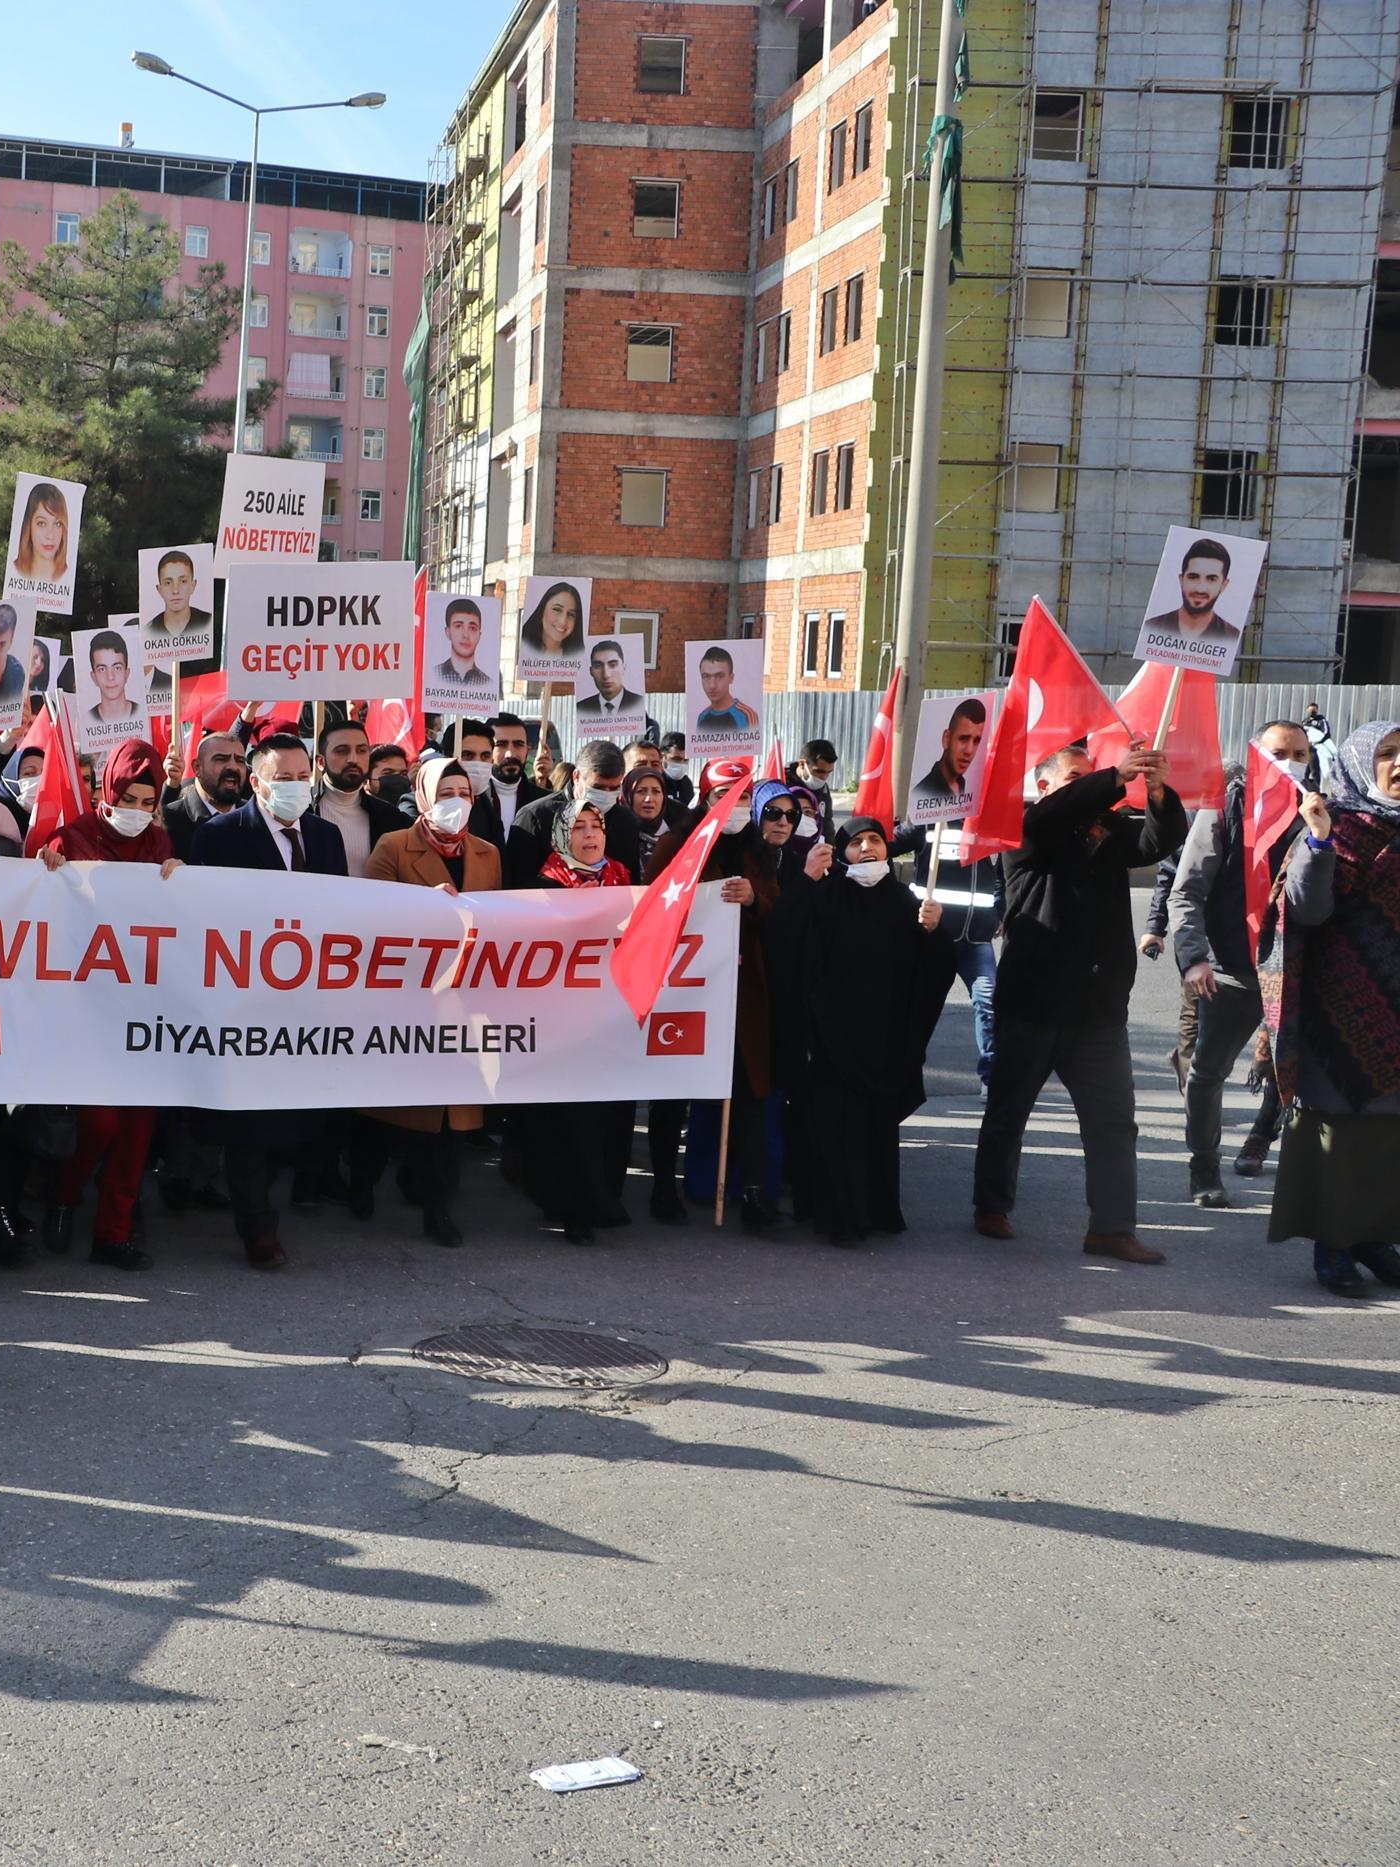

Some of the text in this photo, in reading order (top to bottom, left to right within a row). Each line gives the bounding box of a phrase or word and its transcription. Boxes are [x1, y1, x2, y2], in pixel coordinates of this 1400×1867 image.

[243, 488, 306, 516] 250 AİLE
[222, 523, 316, 554] NÖBETTEYİZ!
[7, 577, 36, 592] AYSUN
[36, 581, 71, 597] ARSLAN
[266, 595, 382, 627] HDPKK
[144, 633, 210, 651] OKAN GÖKKUŞ
[1147, 633, 1227, 658] DOĞAN GÜGER
[241, 637, 402, 681] GEÇİT YOK!
[521, 658, 550, 669] NİLÜFER
[1145, 647, 1181, 660] EVLADIMI
[425, 687, 497, 702] BAYRAM ELHAMAN
[85, 723, 111, 737] YUSUF
[691, 733, 731, 743] RAMAZAN
[916, 797, 942, 810] EREN
[203, 918, 706, 992] NÖBETİNDEZ
[125, 1015, 536, 1057] DİYARBAKIR ANNELERİ
